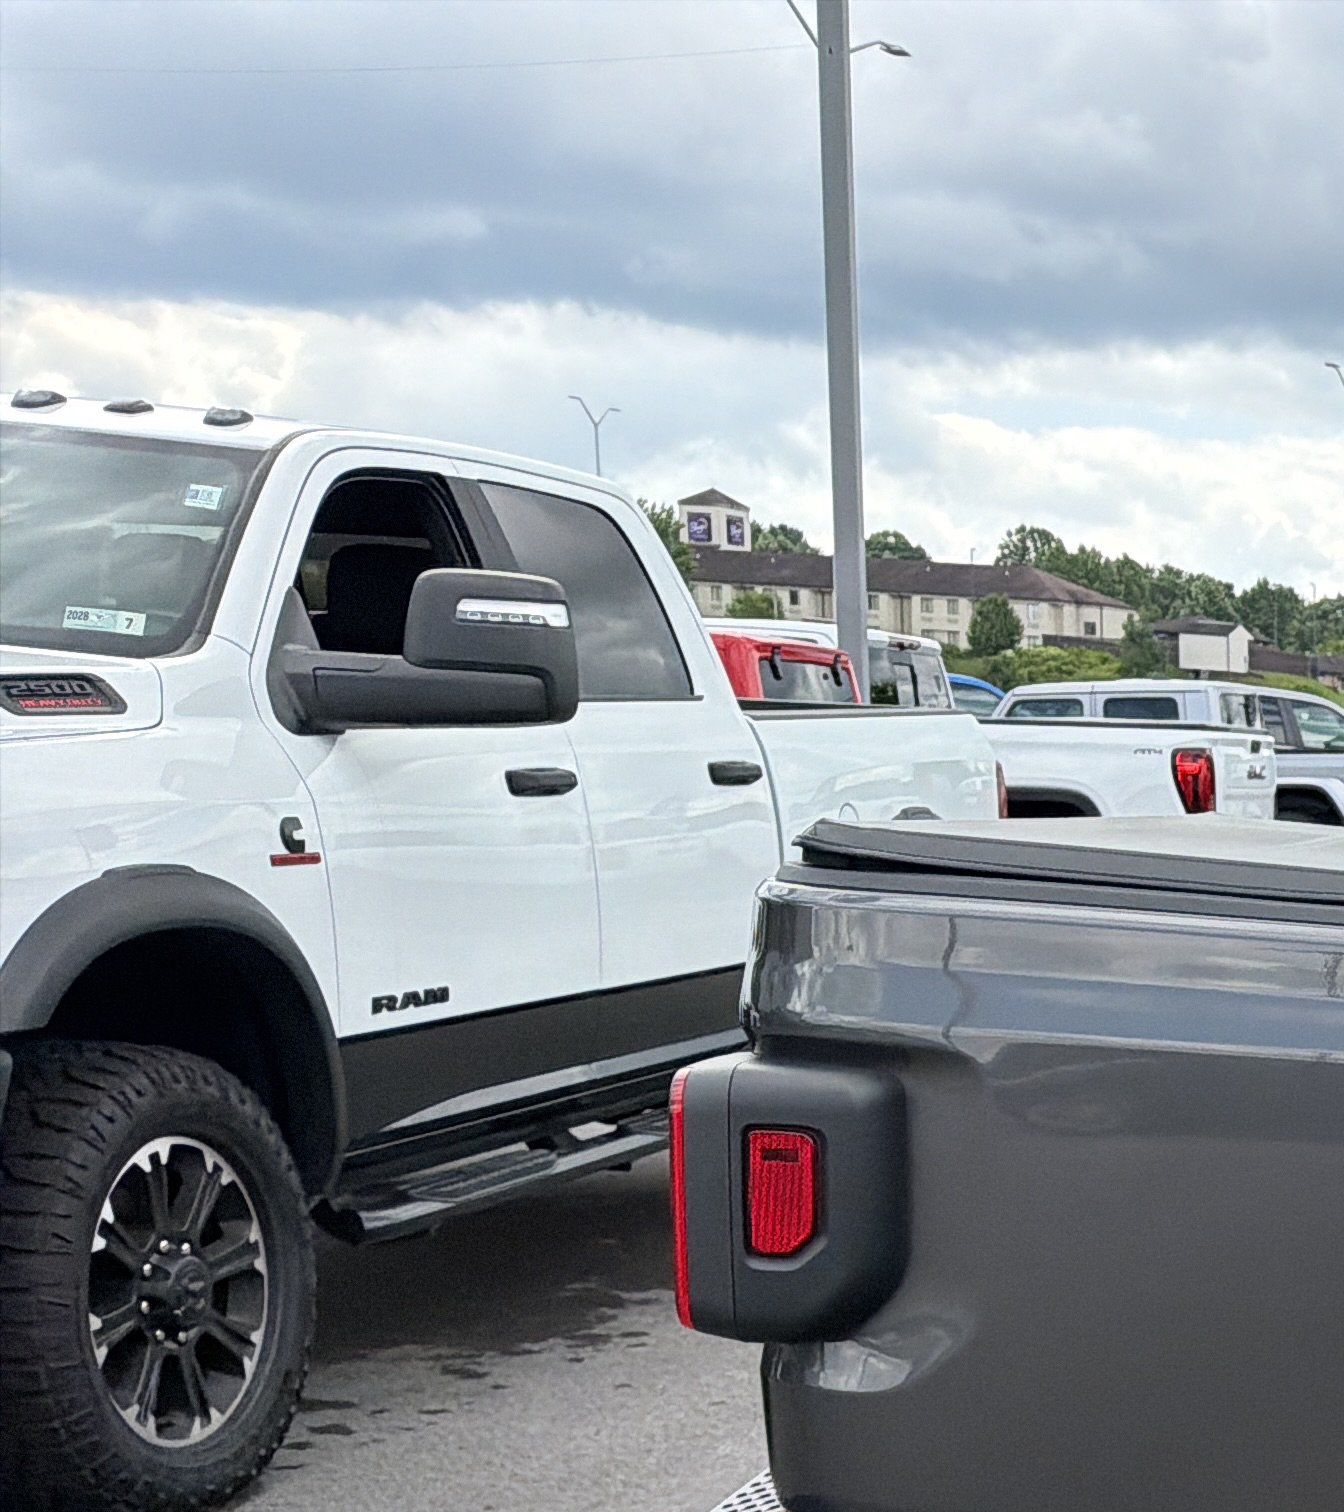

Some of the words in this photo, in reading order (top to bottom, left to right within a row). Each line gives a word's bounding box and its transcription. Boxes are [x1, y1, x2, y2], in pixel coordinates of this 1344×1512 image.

[66, 609, 89, 621] 2028
[125, 617, 134, 630] 7
[4, 680, 93, 696] 2500
[371, 986, 450, 1016] RAM
